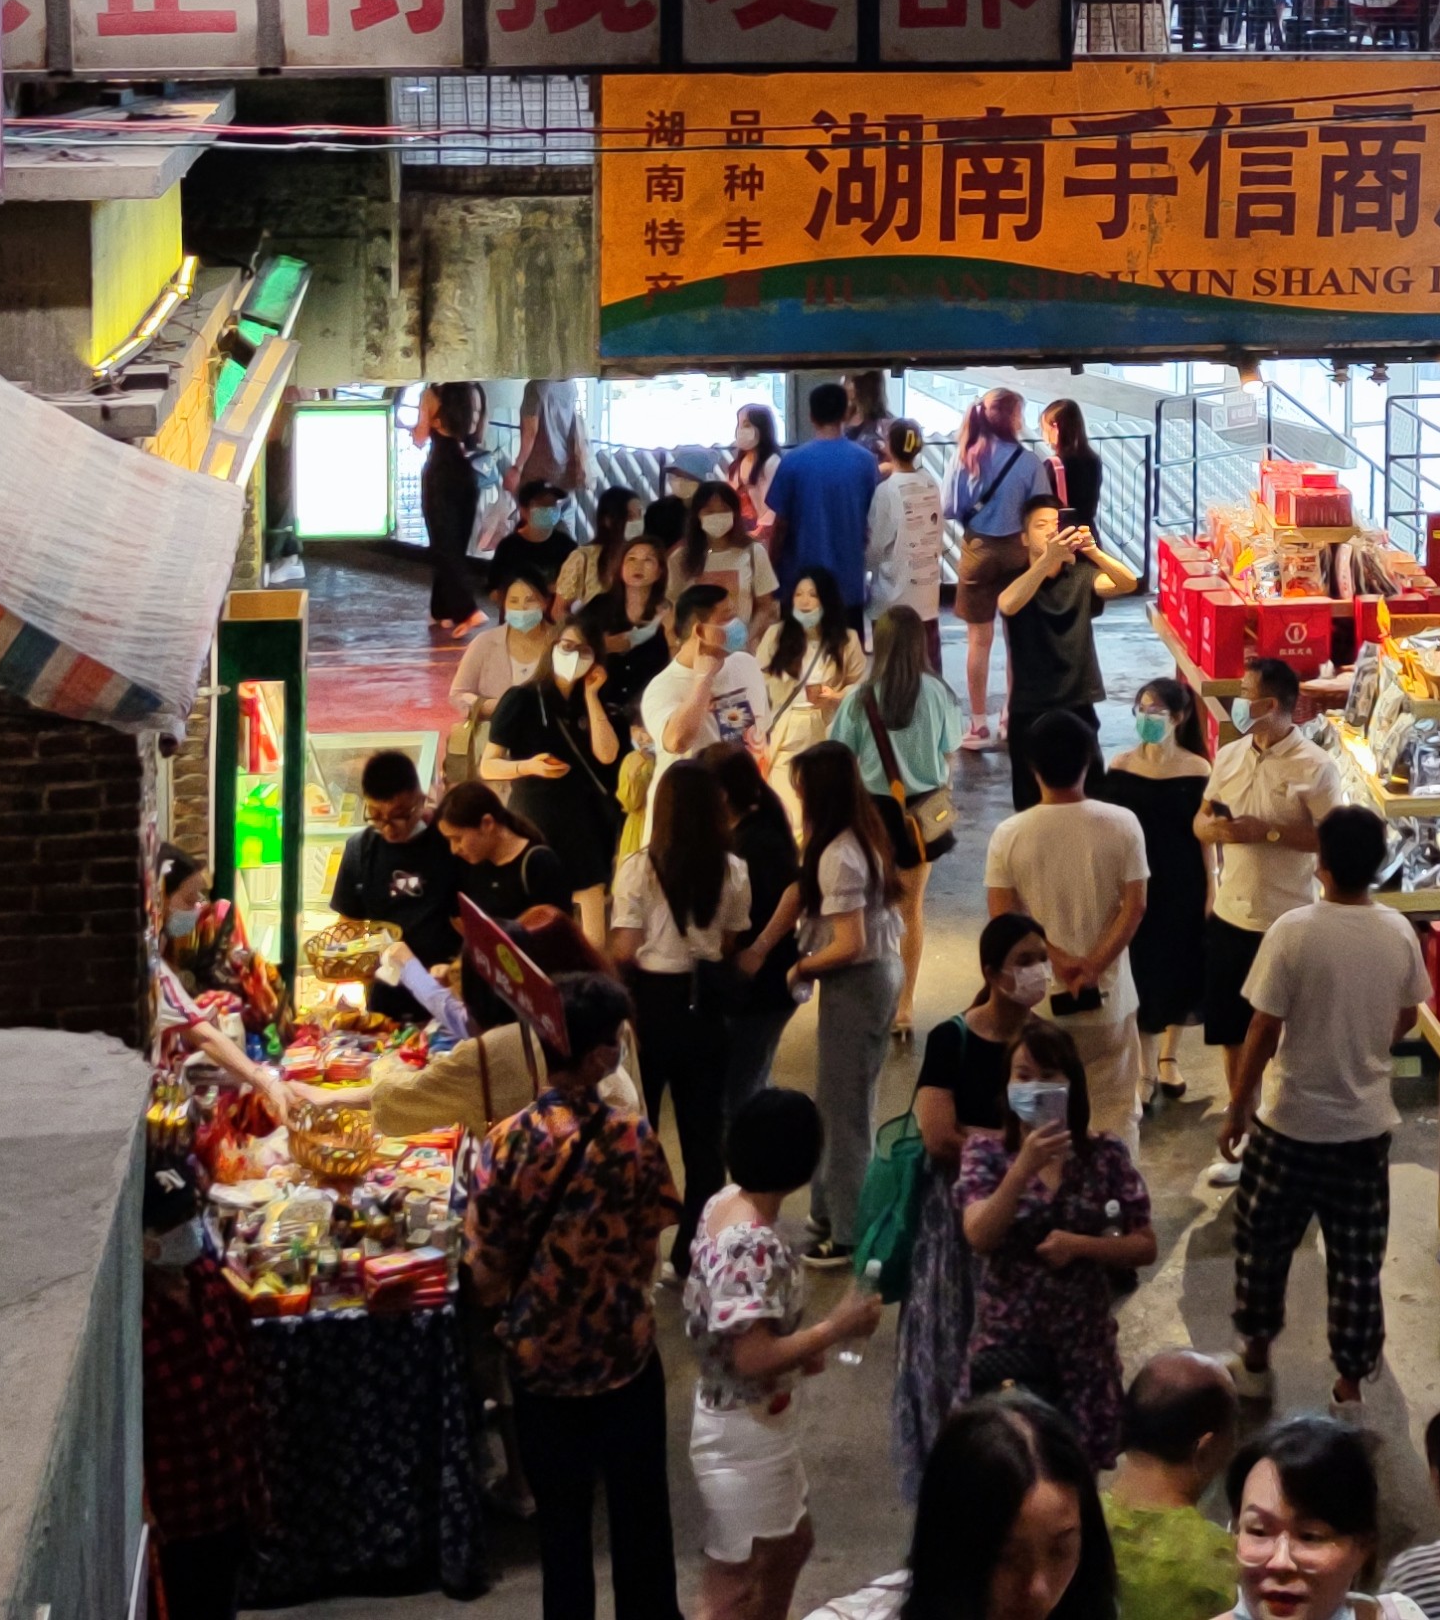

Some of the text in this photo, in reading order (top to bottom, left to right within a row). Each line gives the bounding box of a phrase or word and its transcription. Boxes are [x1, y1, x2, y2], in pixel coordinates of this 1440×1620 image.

[644, 109, 687, 309] 湖南特产
[1154, 268, 1238, 300] XIN
[1251, 265, 1415, 299] SHANG
